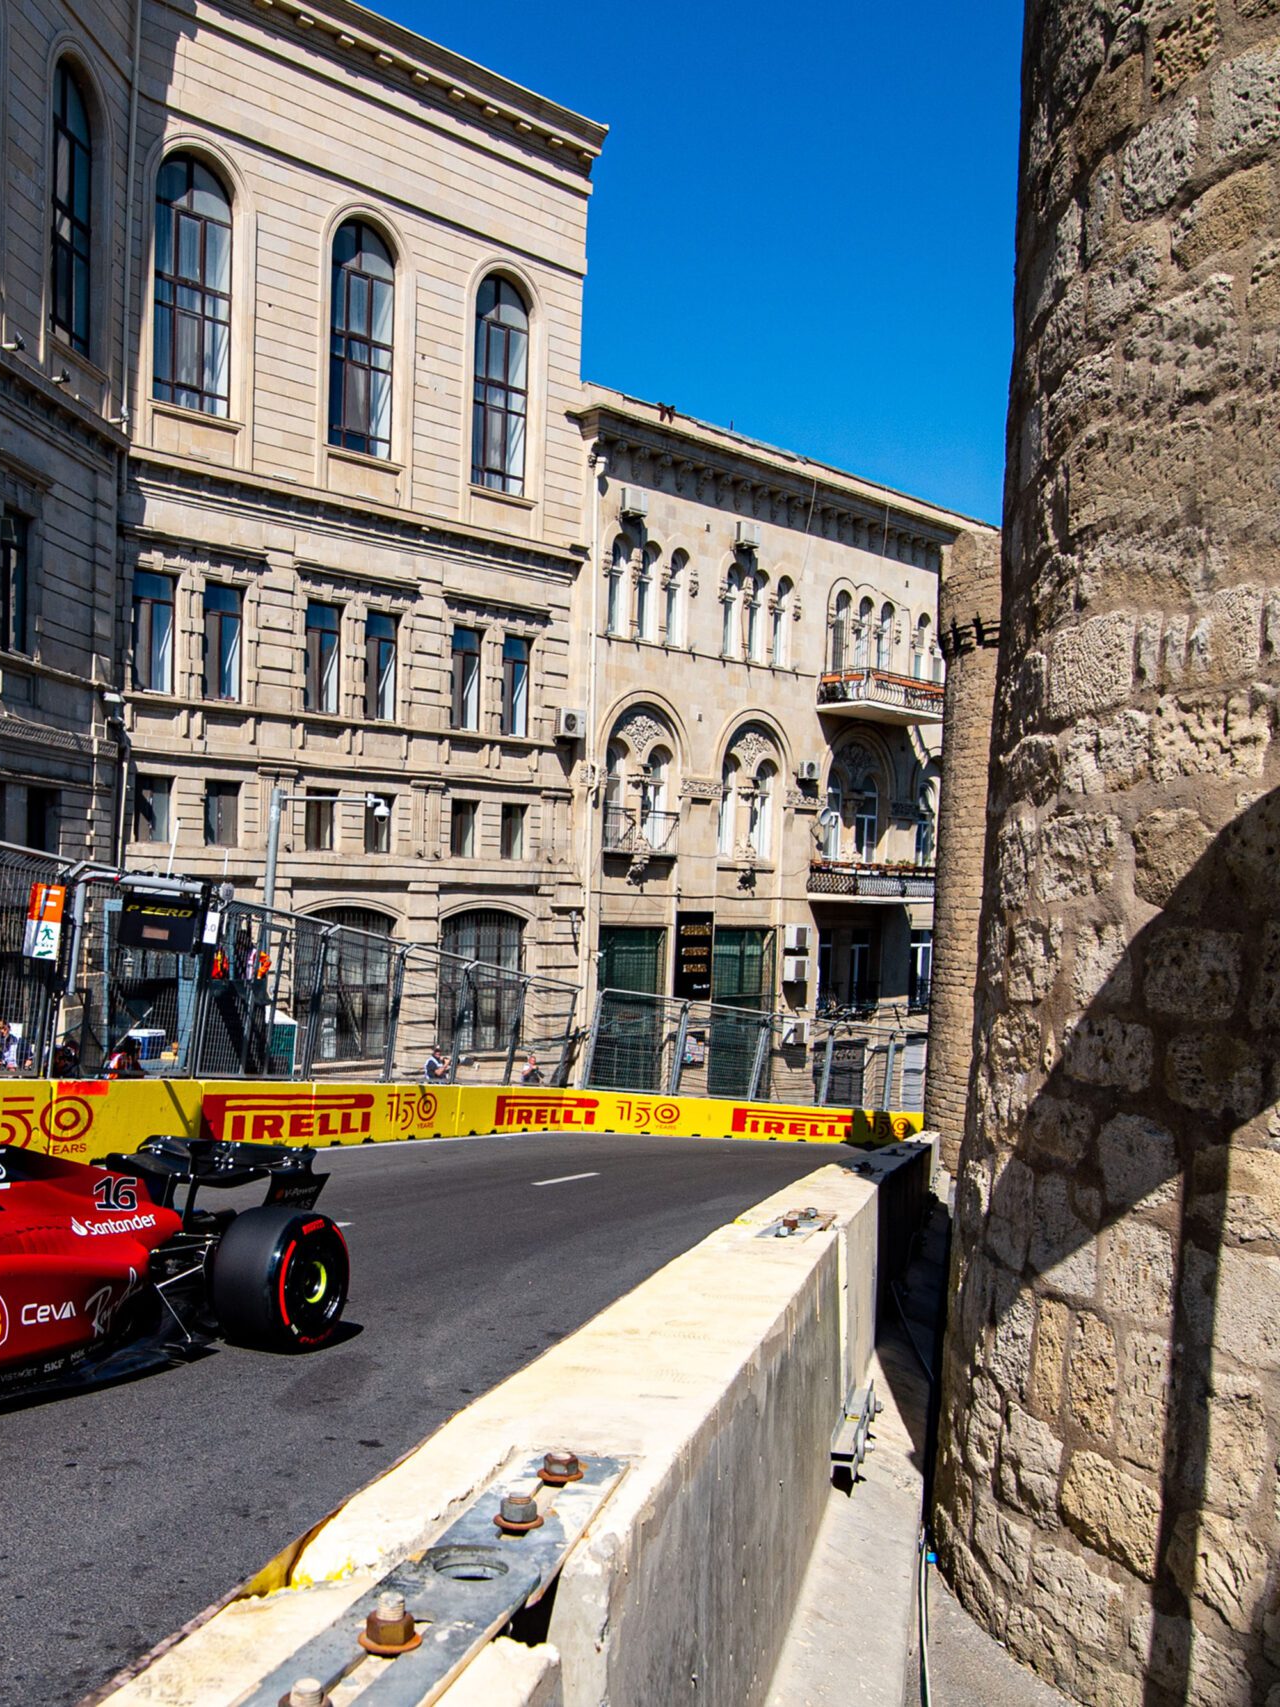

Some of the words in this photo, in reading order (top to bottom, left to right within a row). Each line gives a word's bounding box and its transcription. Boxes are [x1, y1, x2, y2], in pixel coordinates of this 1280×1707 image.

[39, 888, 61, 917] F
[125, 904, 140, 912] P
[141, 906, 194, 918] ZERO
[200, 1093, 375, 1141] PIRELLI
[387, 1092, 437, 1130] 150
[494, 1095, 600, 1126] PIRELLI
[616, 1100, 680, 1128] 150
[731, 1108, 853, 1138] PIRELLI
[43, 1143, 87, 1155] YEARS
[93, 1176, 138, 1212] 16
[87, 1213, 157, 1236] Santander
[43, 1358, 65, 1373] SKF
